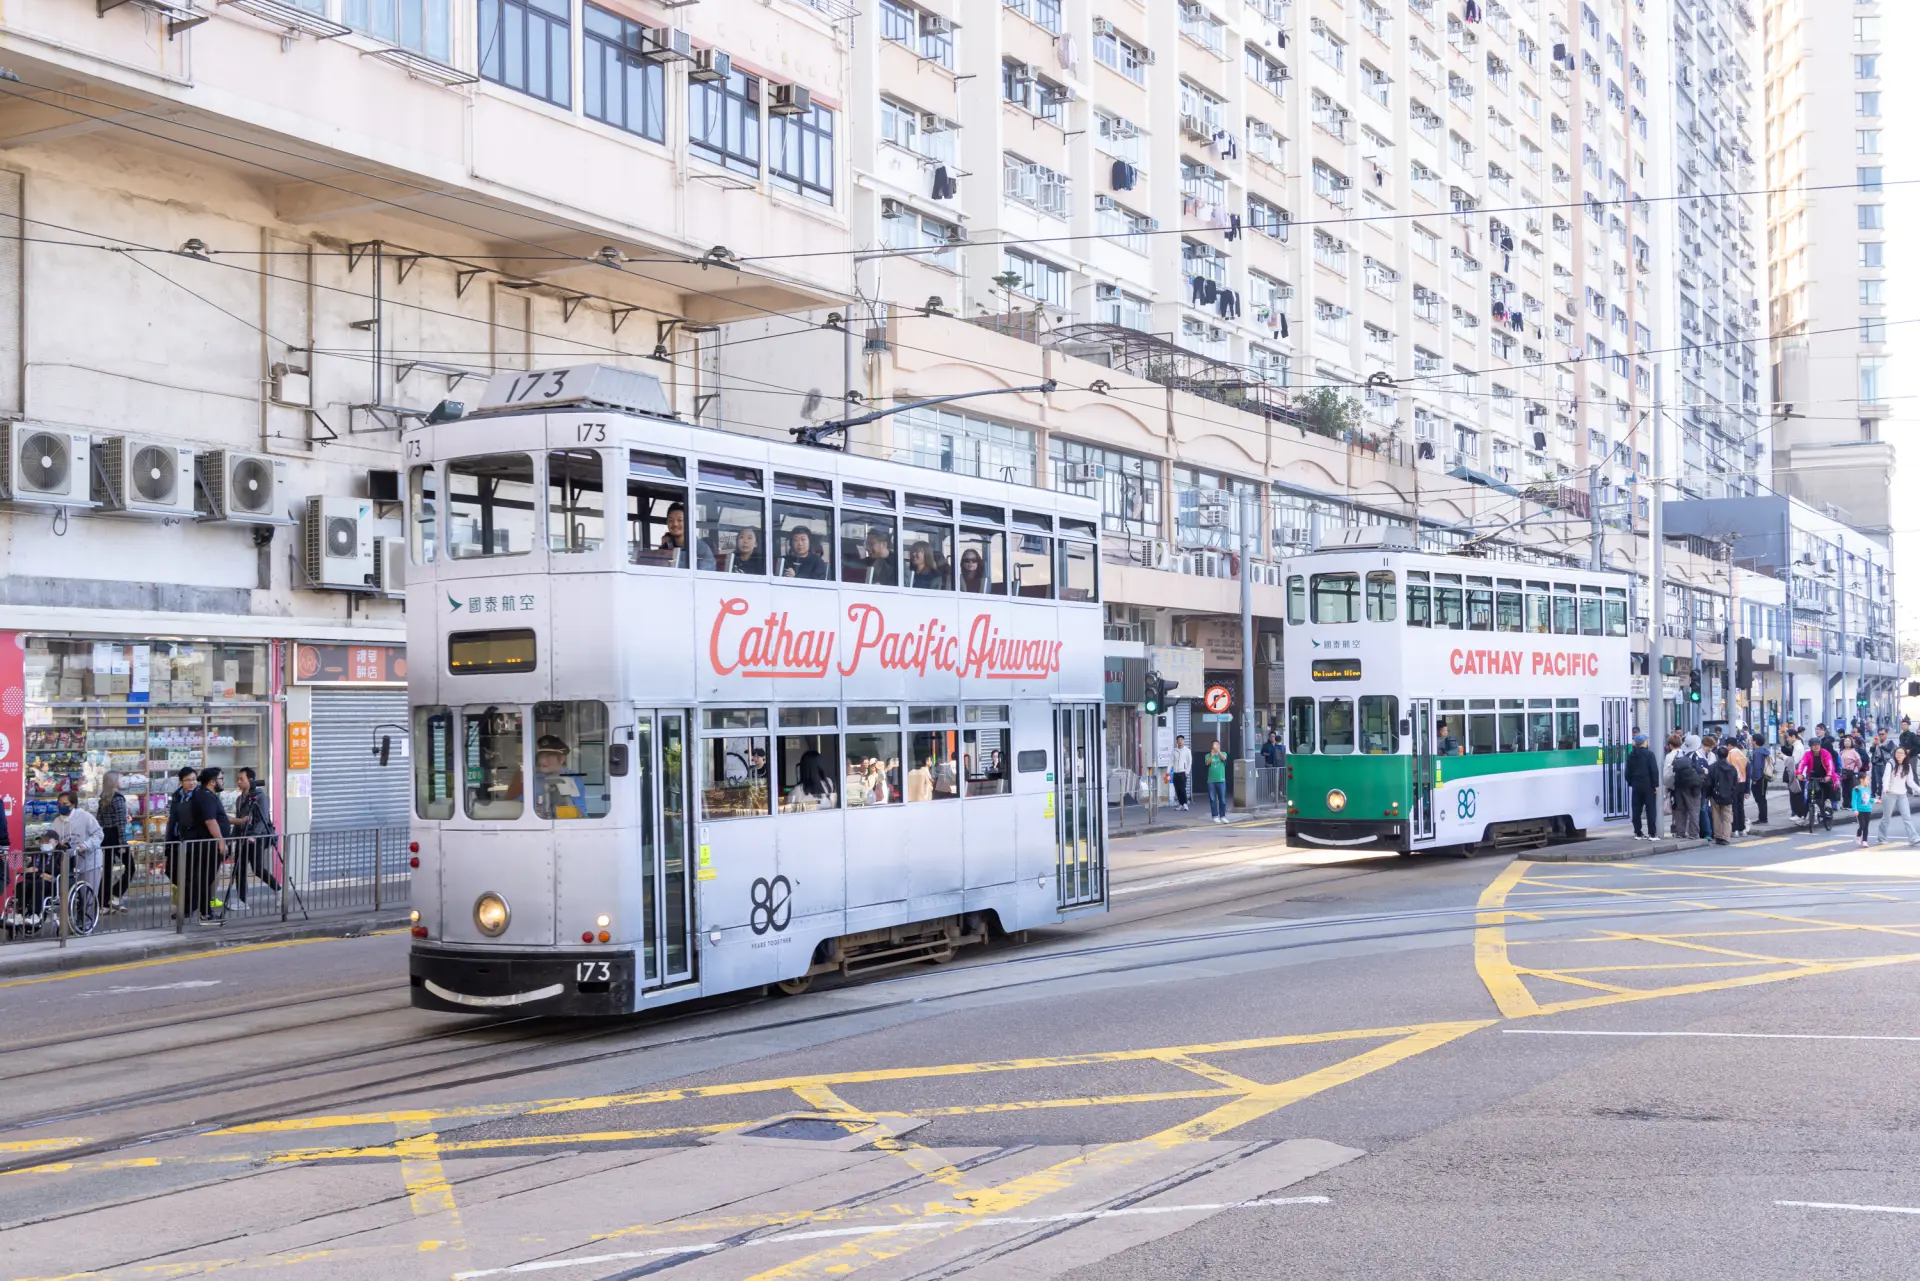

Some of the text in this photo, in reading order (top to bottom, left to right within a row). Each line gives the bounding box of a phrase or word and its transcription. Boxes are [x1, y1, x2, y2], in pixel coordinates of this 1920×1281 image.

[506, 370, 569, 402] 173
[577, 423, 606, 442] 173
[405, 439, 421, 459] 173
[468, 594, 535, 613] 國泰航空
[709, 597, 1064, 679] Cathay Pacific Airways
[1450, 648, 1599, 677] CATHAY PACIFIC
[1457, 788, 1476, 819] 80
[750, 874, 792, 936] 80
[767, 937, 792, 946] TOGETHER
[576, 961, 611, 982] 173
